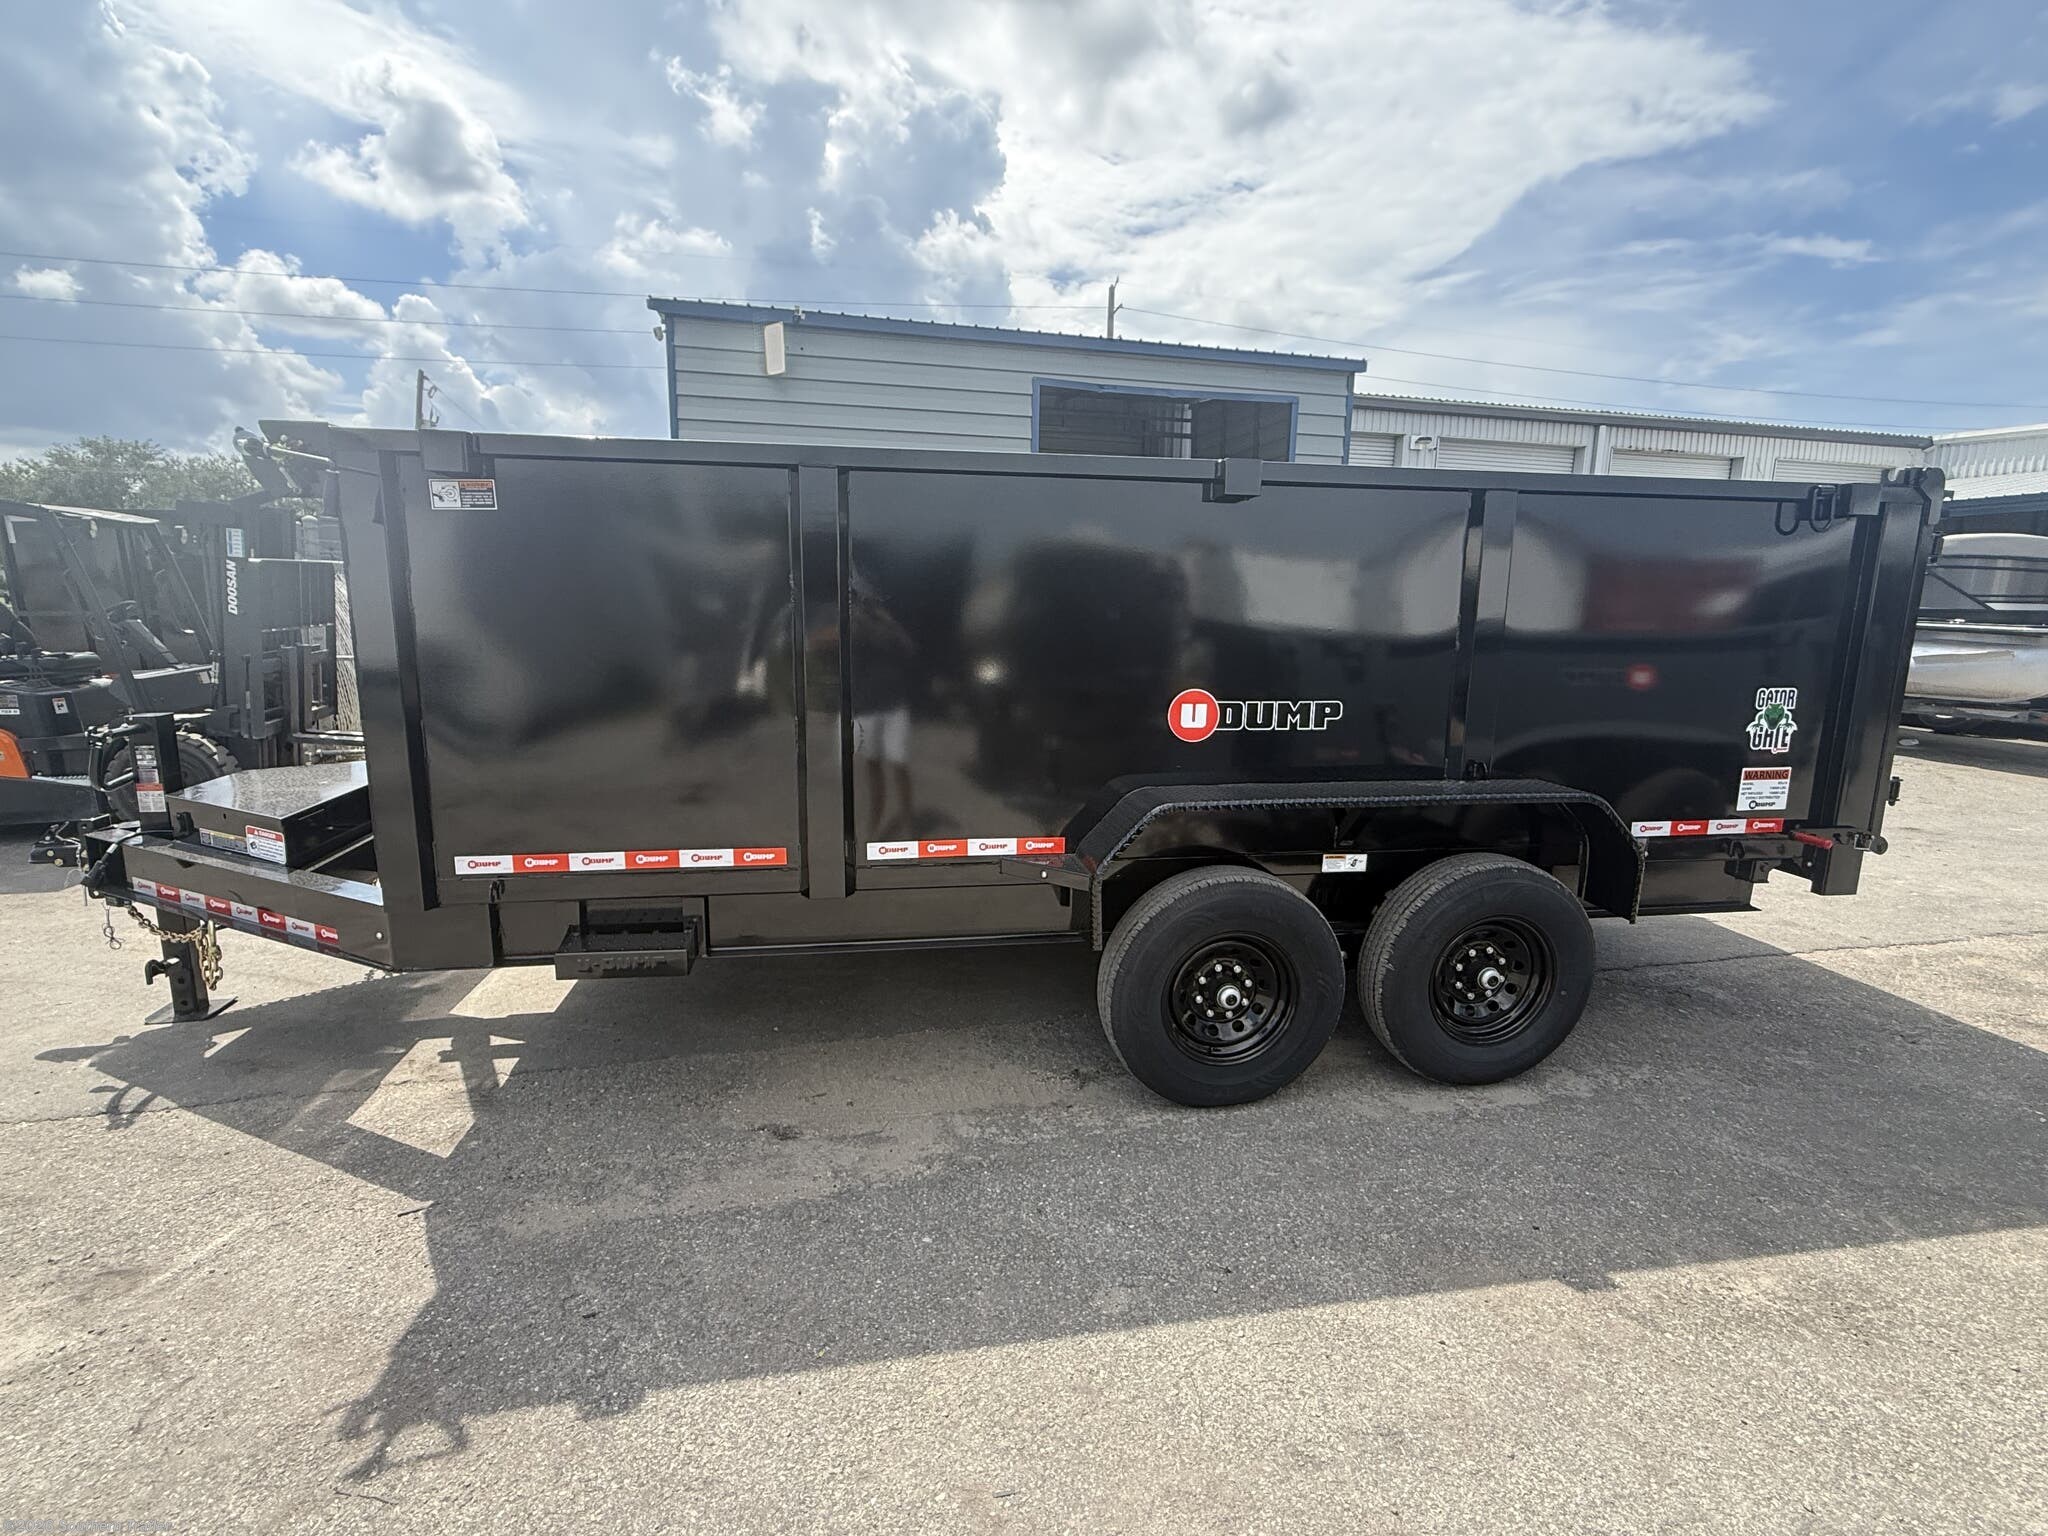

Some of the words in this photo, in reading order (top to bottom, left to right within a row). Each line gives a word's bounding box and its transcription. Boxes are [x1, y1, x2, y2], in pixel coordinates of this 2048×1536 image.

[226, 559, 238, 615] DOOSAN
[1756, 688, 1797, 709] GATOR
[1743, 770, 1790, 780] WARNING
